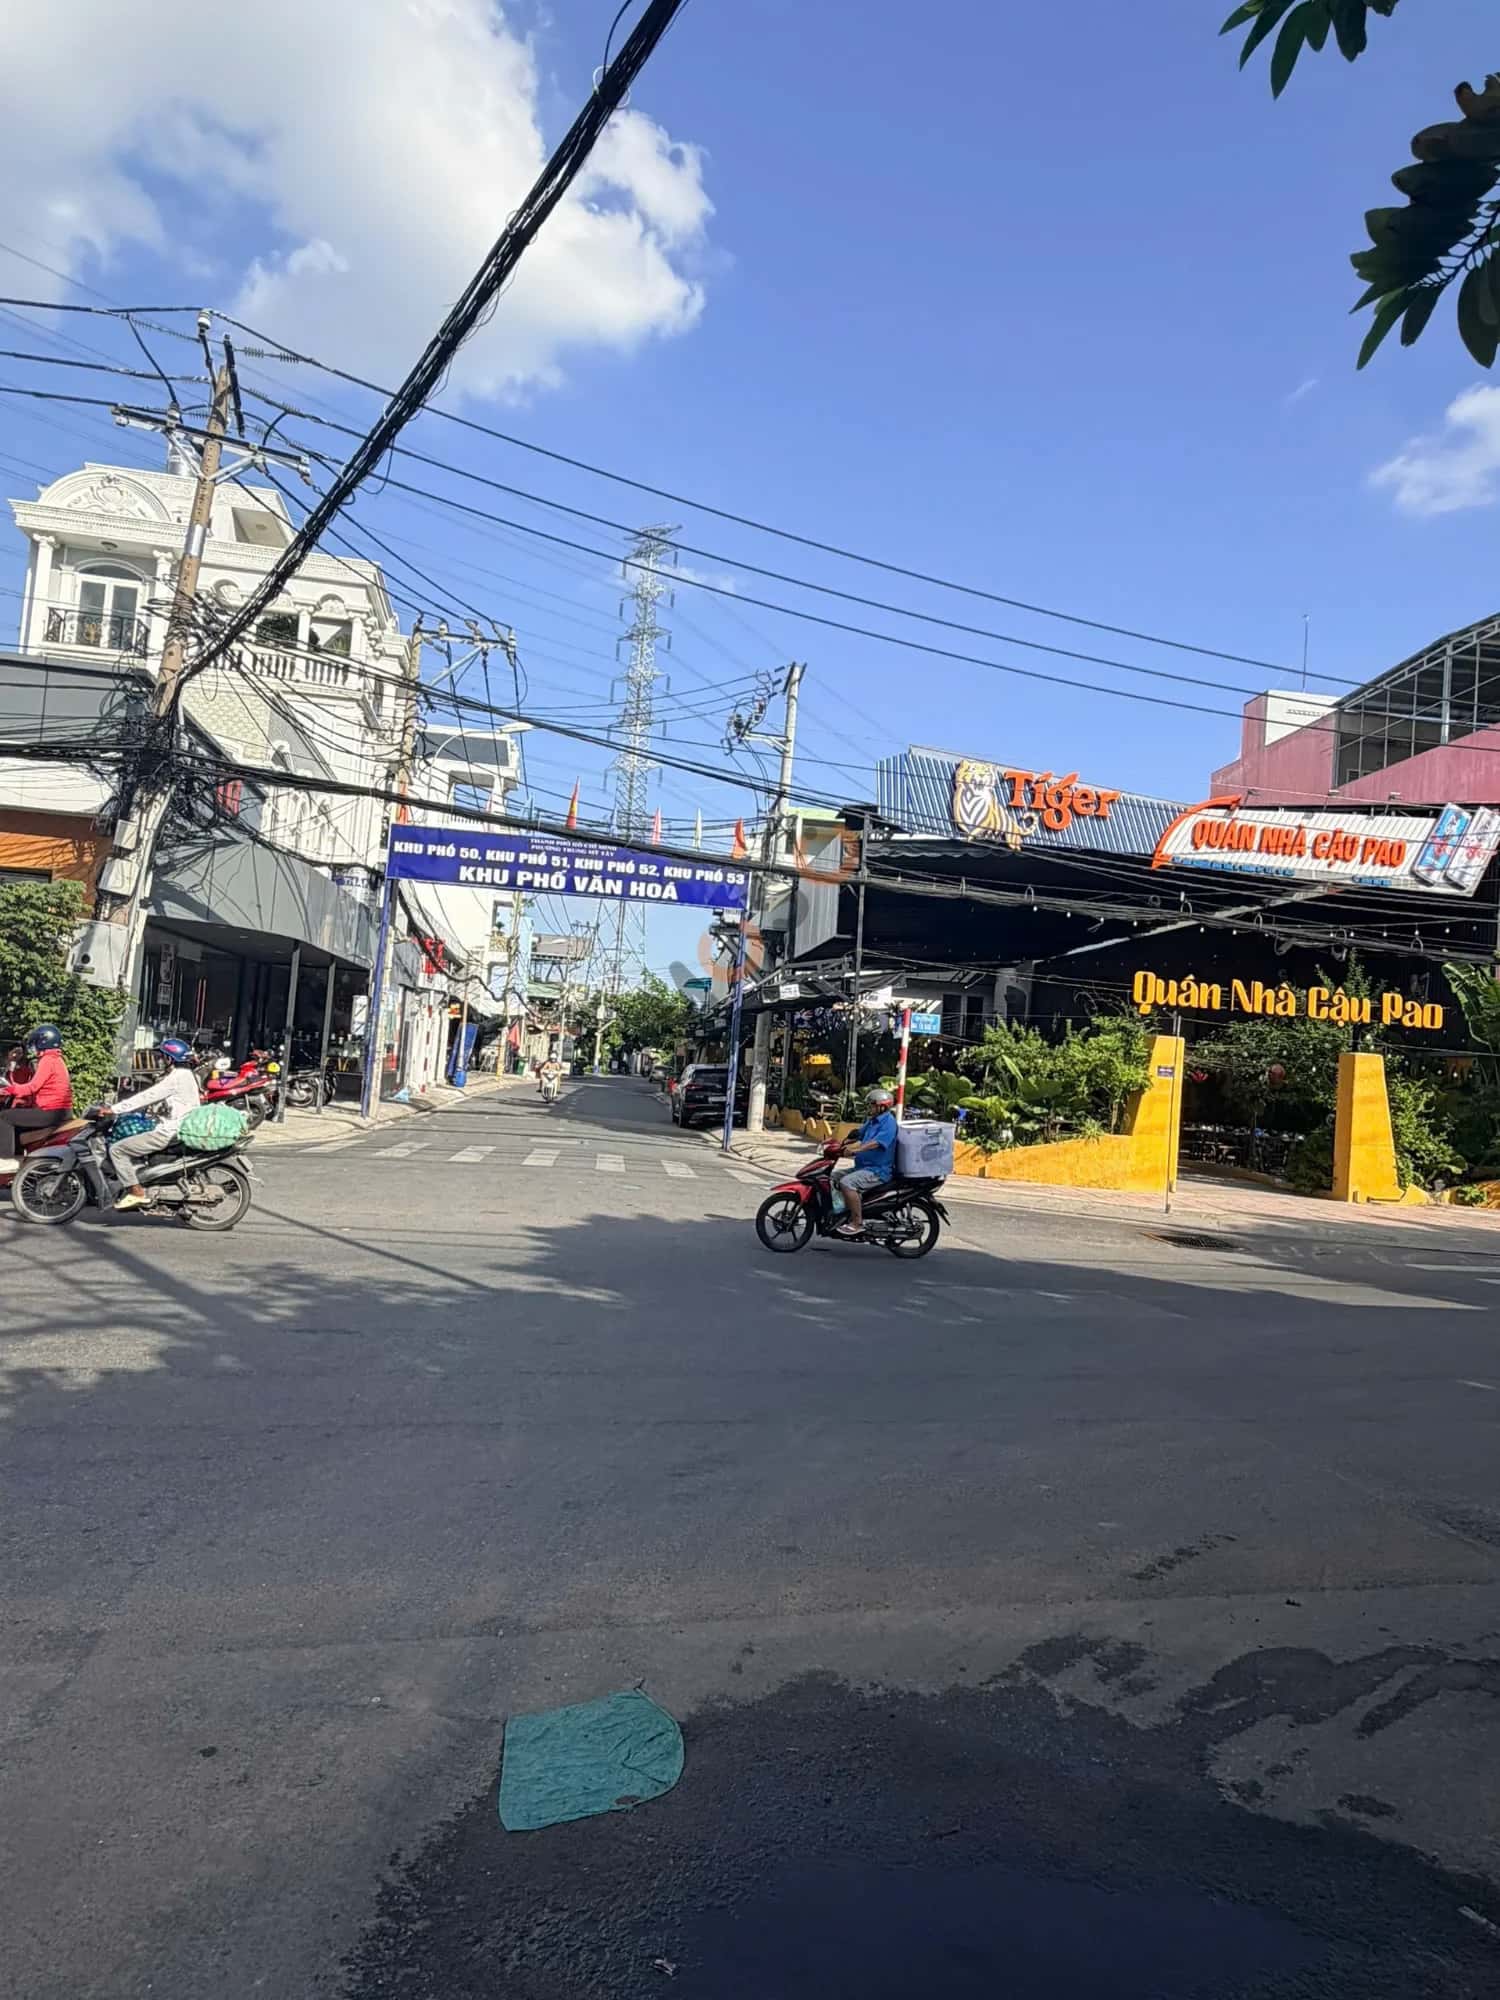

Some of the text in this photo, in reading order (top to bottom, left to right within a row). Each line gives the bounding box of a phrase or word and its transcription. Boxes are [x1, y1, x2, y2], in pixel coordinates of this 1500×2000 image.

[1004, 771, 1119, 831] Tiger
[394, 841, 423, 855] KHU
[460, 847, 482, 861] 50,
[485, 851, 515, 864] KHU
[551, 855, 570, 869] 51,
[575, 857, 603, 871] KHU
[639, 864, 660, 877] 52,
[664, 865, 692, 880] KHU
[727, 872, 745, 885] 53
[1192, 817, 1257, 850] QUÁN
[1259, 823, 1306, 856] NHÀ
[1311, 828, 1360, 867] CẬU
[1361, 838, 1407, 867] PAO
[459, 865, 678, 900] KHU PHỐ VĂN HOÁ
[1133, 971, 1443, 1029] Quán Nhà Cậu Pao
